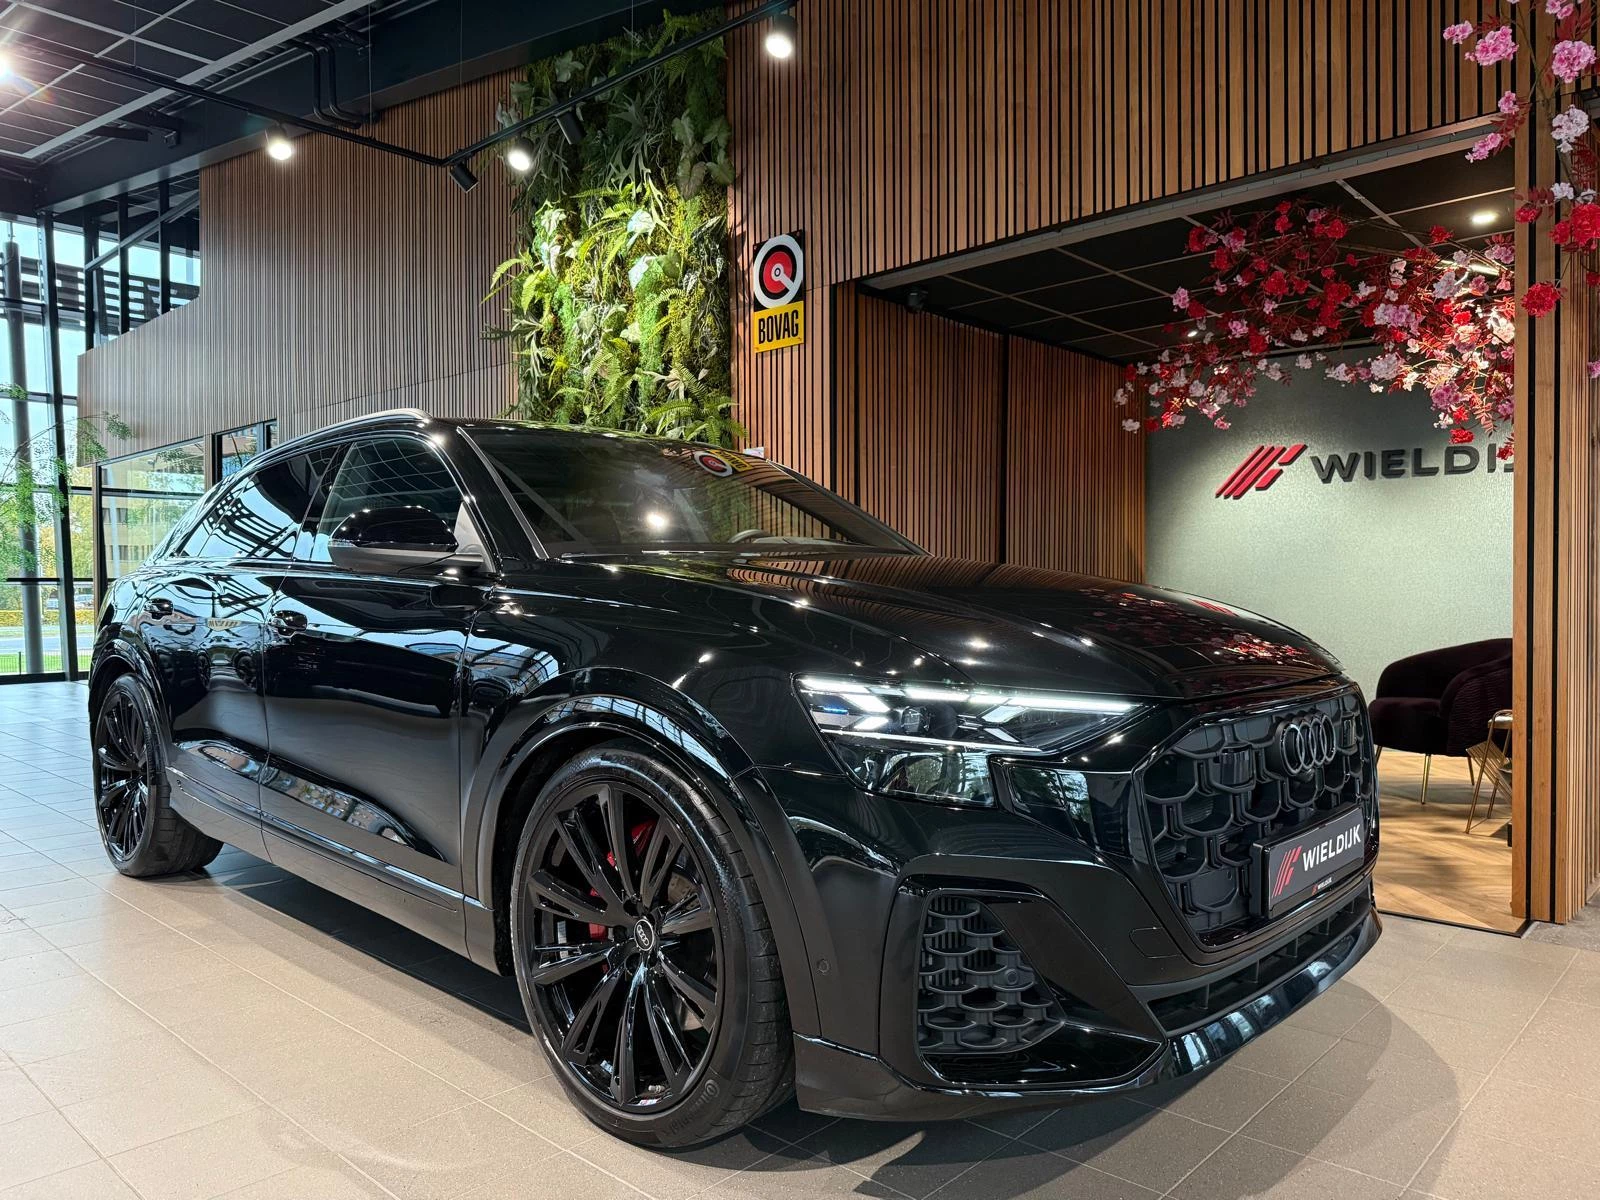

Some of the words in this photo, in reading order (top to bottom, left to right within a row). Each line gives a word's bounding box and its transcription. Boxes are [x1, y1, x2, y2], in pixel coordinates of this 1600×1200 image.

[758, 309, 799, 345] BOVAG
[1310, 443, 1514, 484] WIELDI
[1302, 823, 1361, 871] WIELDIJK
